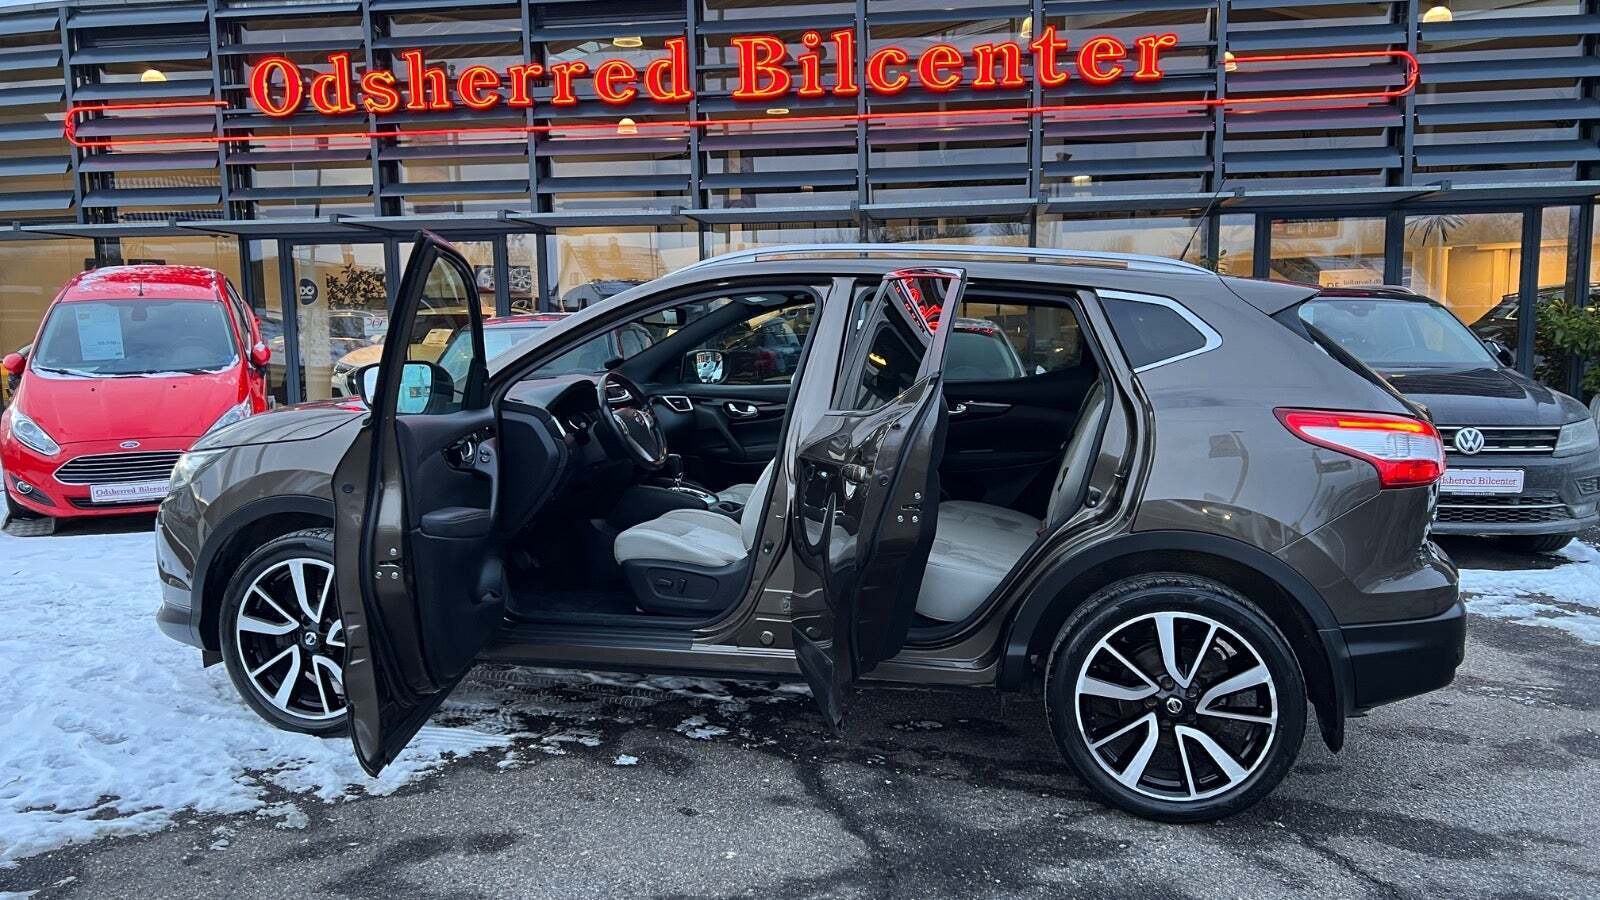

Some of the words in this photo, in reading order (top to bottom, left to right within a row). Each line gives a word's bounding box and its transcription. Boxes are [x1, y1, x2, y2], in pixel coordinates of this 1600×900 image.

[249, 37, 693, 118] Odsherred
[732, 27, 1178, 99] Bilcenter
[1457, 428, 1483, 454] VW
[1478, 476, 1517, 485] Bilcenter
[95, 487, 136, 496] Odsherred
[139, 485, 169, 493] Bilcente
